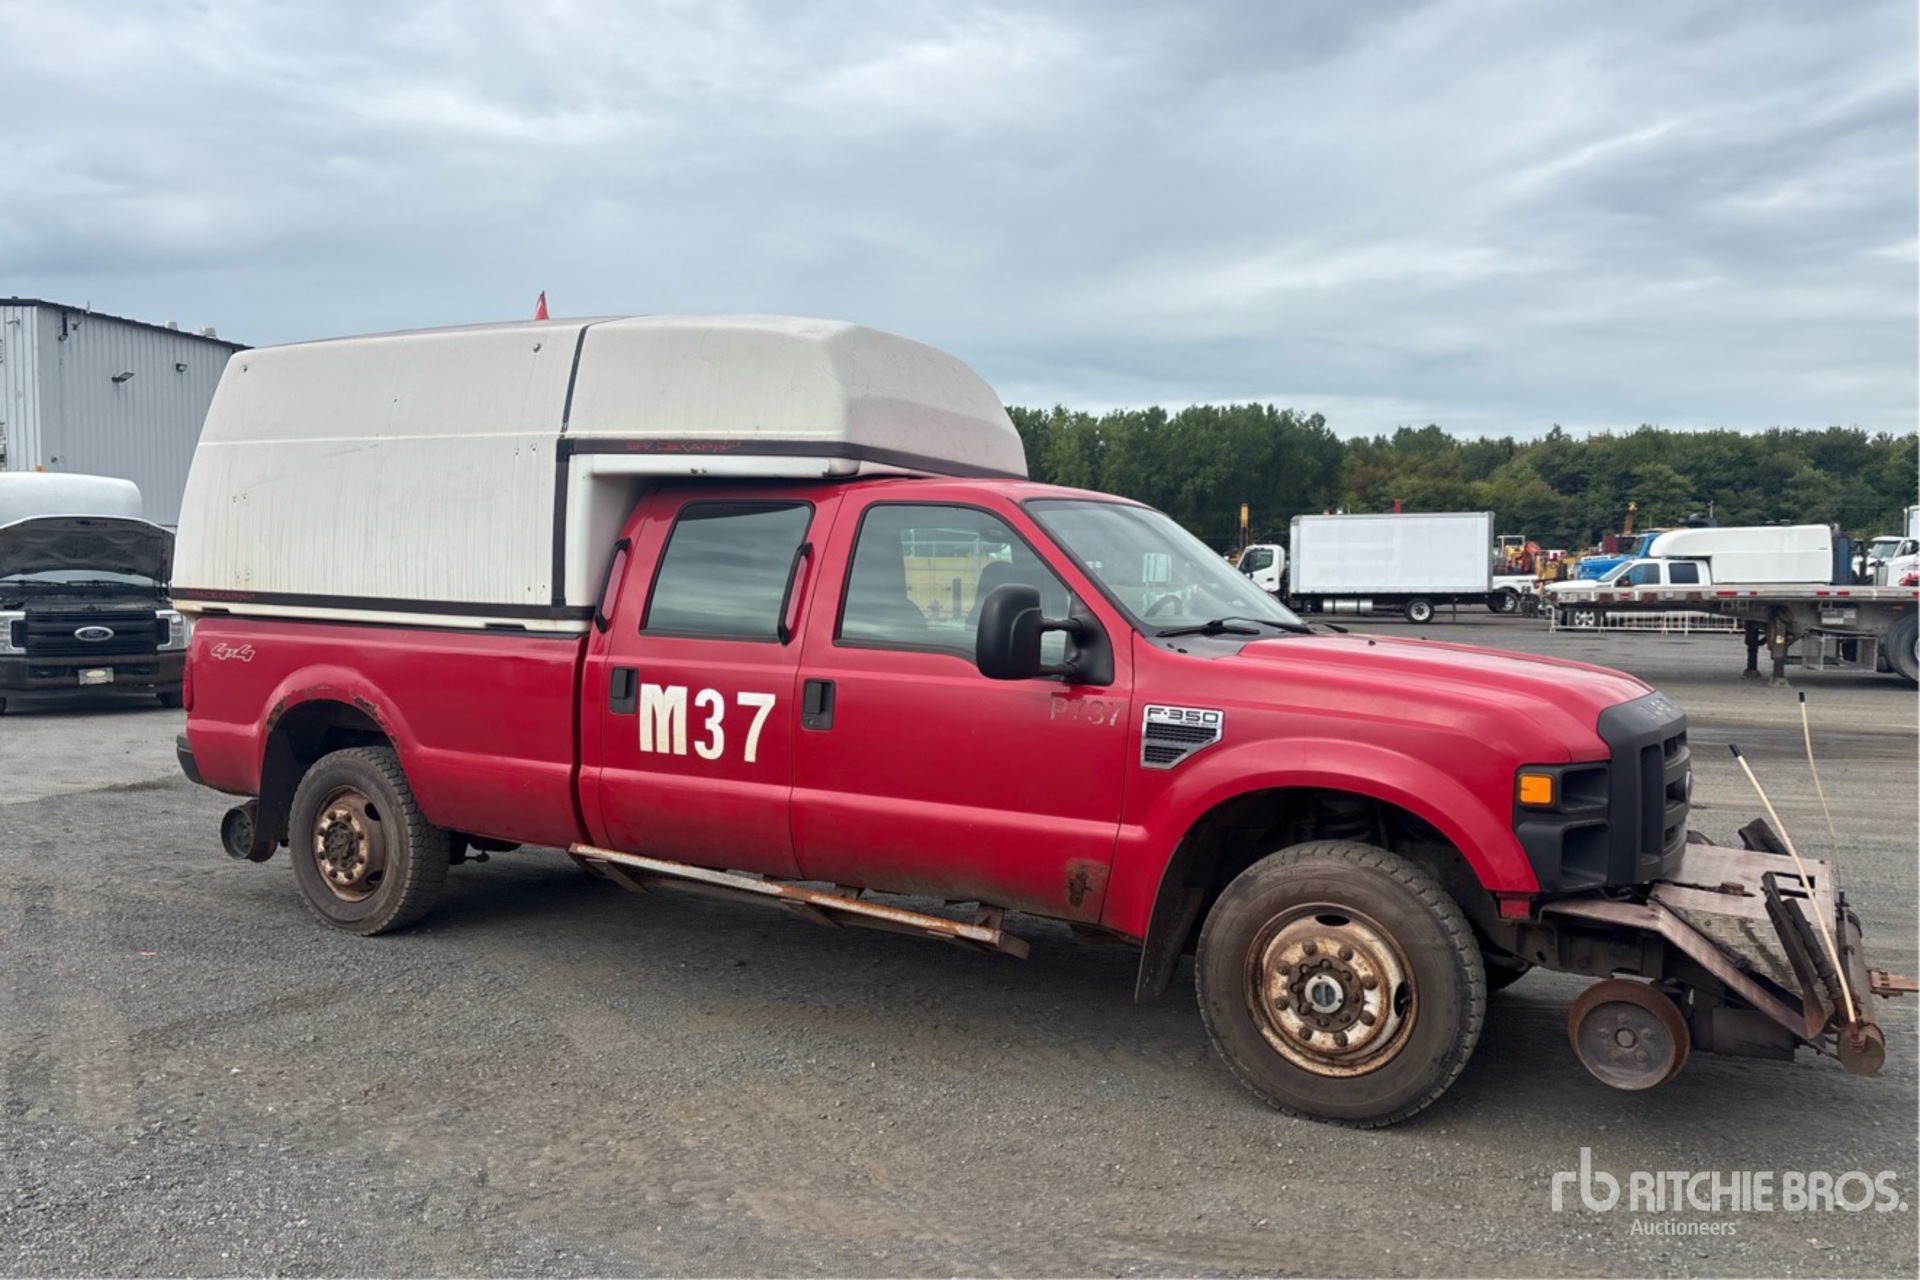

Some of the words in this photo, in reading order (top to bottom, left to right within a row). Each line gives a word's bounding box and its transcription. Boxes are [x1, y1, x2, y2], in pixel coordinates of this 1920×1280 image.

[210, 642, 256, 662] 4x4
[639, 683, 776, 763] M37
[1050, 696, 1124, 727] P737
